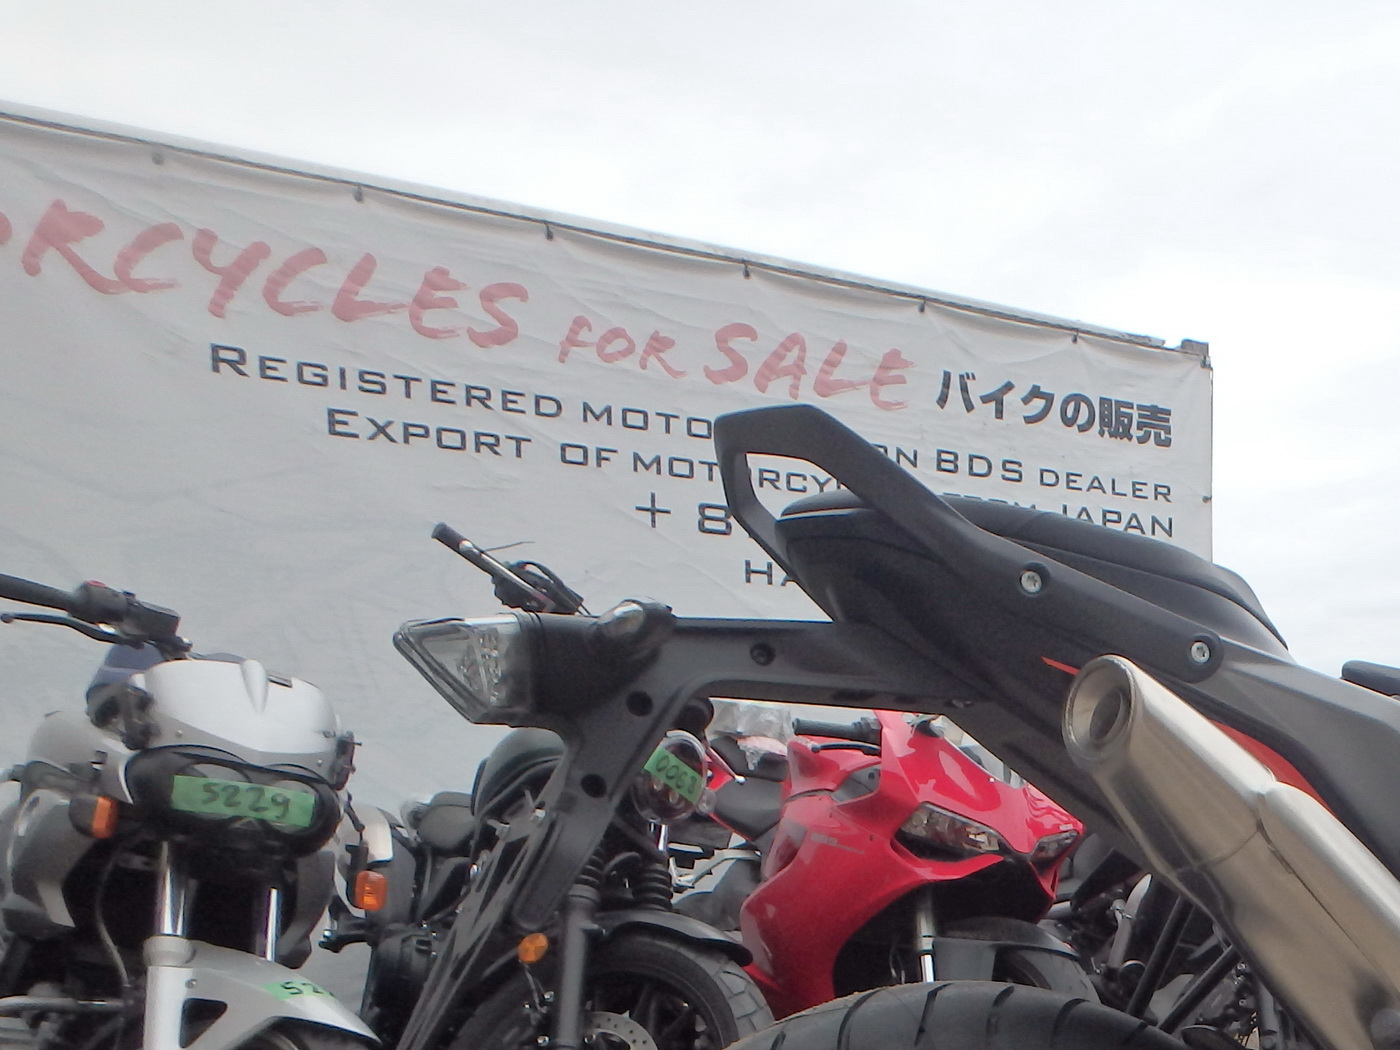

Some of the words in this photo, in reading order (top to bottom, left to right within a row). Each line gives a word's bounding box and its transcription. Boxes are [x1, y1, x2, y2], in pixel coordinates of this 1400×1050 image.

[558, 314, 687, 379] FOR
[703, 322, 916, 411] SALE
[210, 342, 563, 418] REGISTERED
[582, 401, 713, 440] MOTO
[935, 448, 1024, 483] BDS
[1039, 467, 1173, 503] DEALER
[326, 407, 532, 460] EXPORT
[560, 442, 618, 468] OF
[935, 369, 1173, 448] バイクの販売
[697, 502, 738, 536] 8
